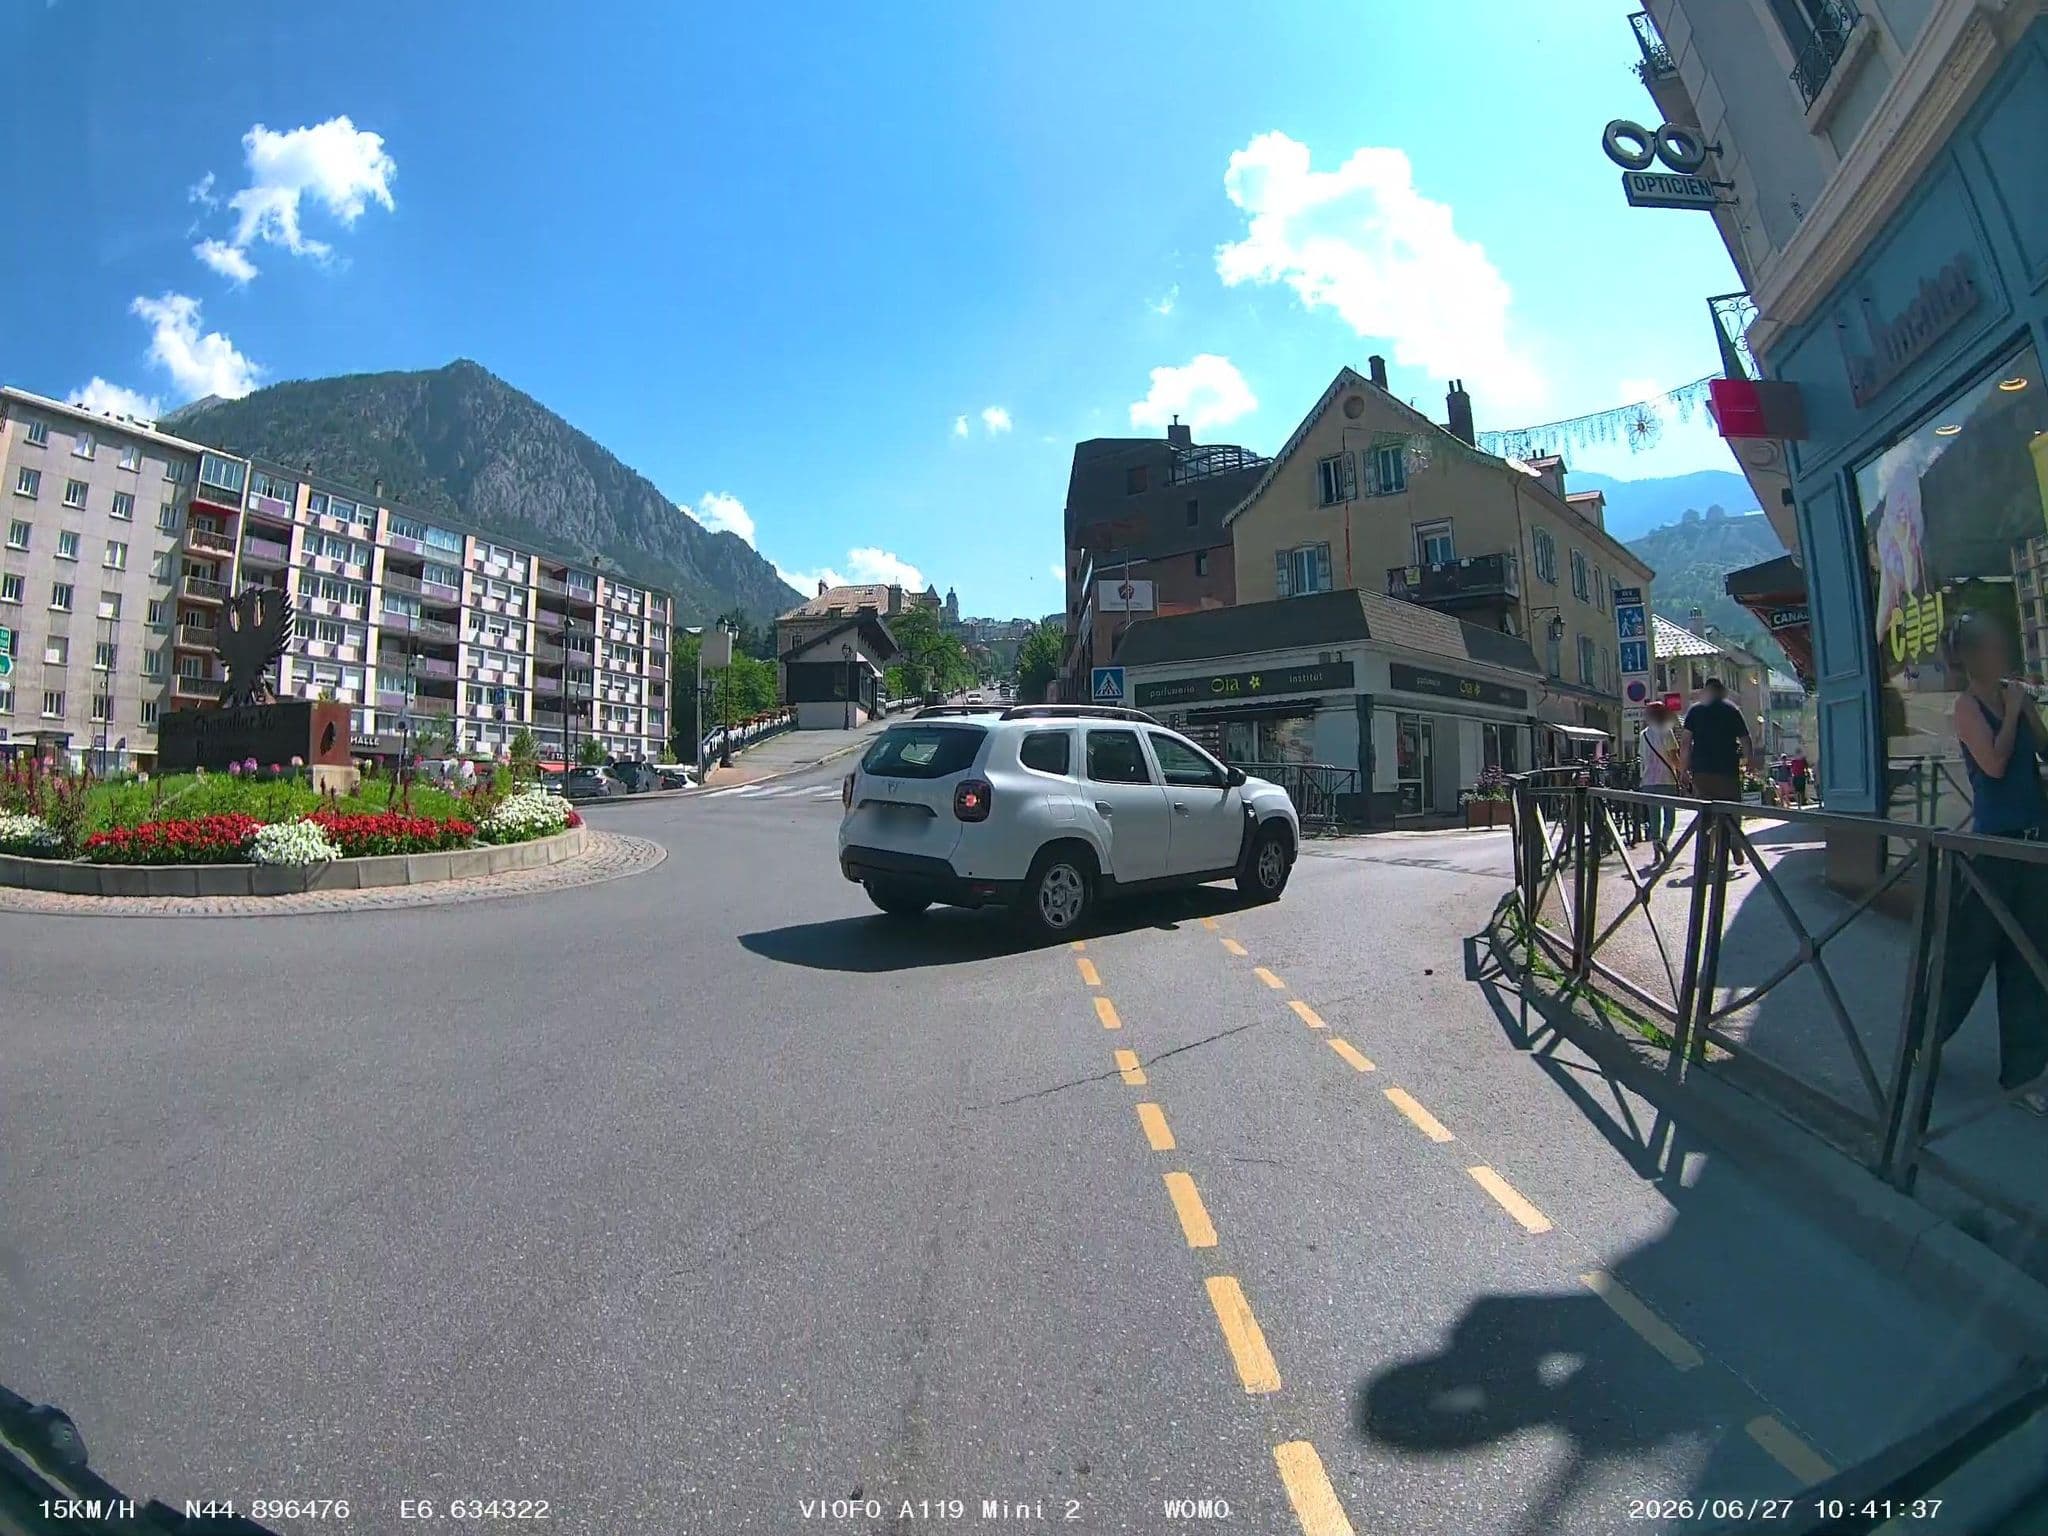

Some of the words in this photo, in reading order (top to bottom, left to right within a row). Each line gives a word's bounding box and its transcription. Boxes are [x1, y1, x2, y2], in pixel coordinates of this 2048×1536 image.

[1633, 175, 1712, 197] OPTICIEN
[1288, 671, 1324, 684] institut
[350, 735, 380, 746] HALLE
